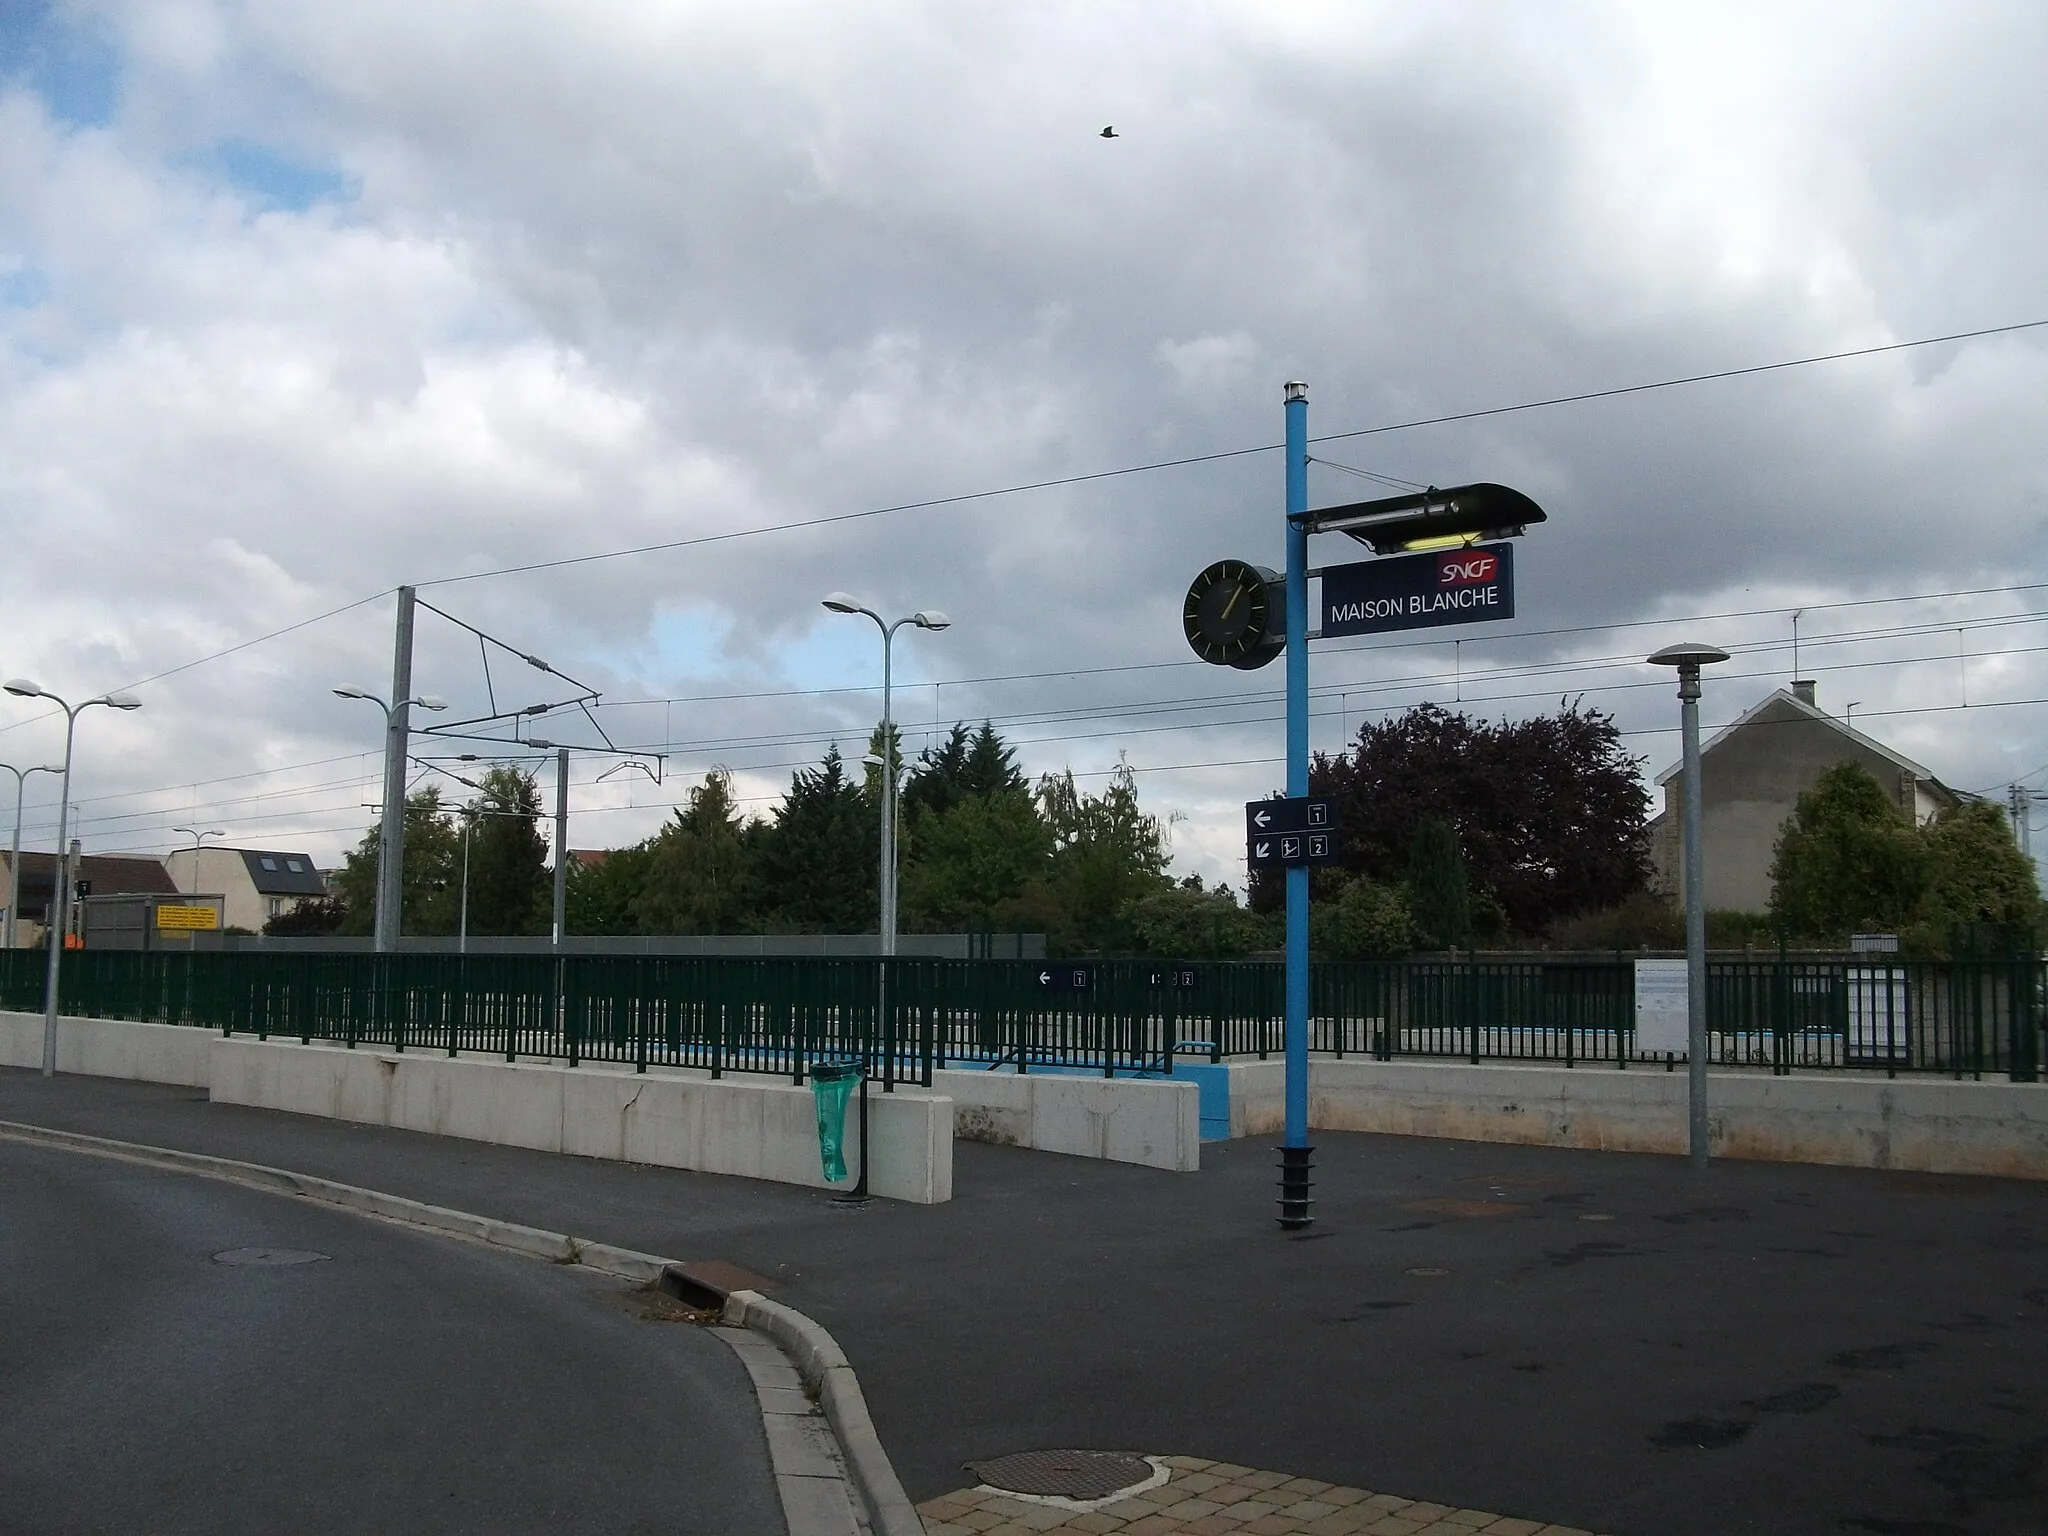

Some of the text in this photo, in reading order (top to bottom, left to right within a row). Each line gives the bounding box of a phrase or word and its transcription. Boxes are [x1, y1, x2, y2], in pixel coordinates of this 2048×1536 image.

[1441, 558, 1495, 582] SNCF
[1331, 586, 1498, 623] MAISON BLANCHE
[1315, 812, 1320, 822] 1
[1315, 843, 1322, 854] 2
